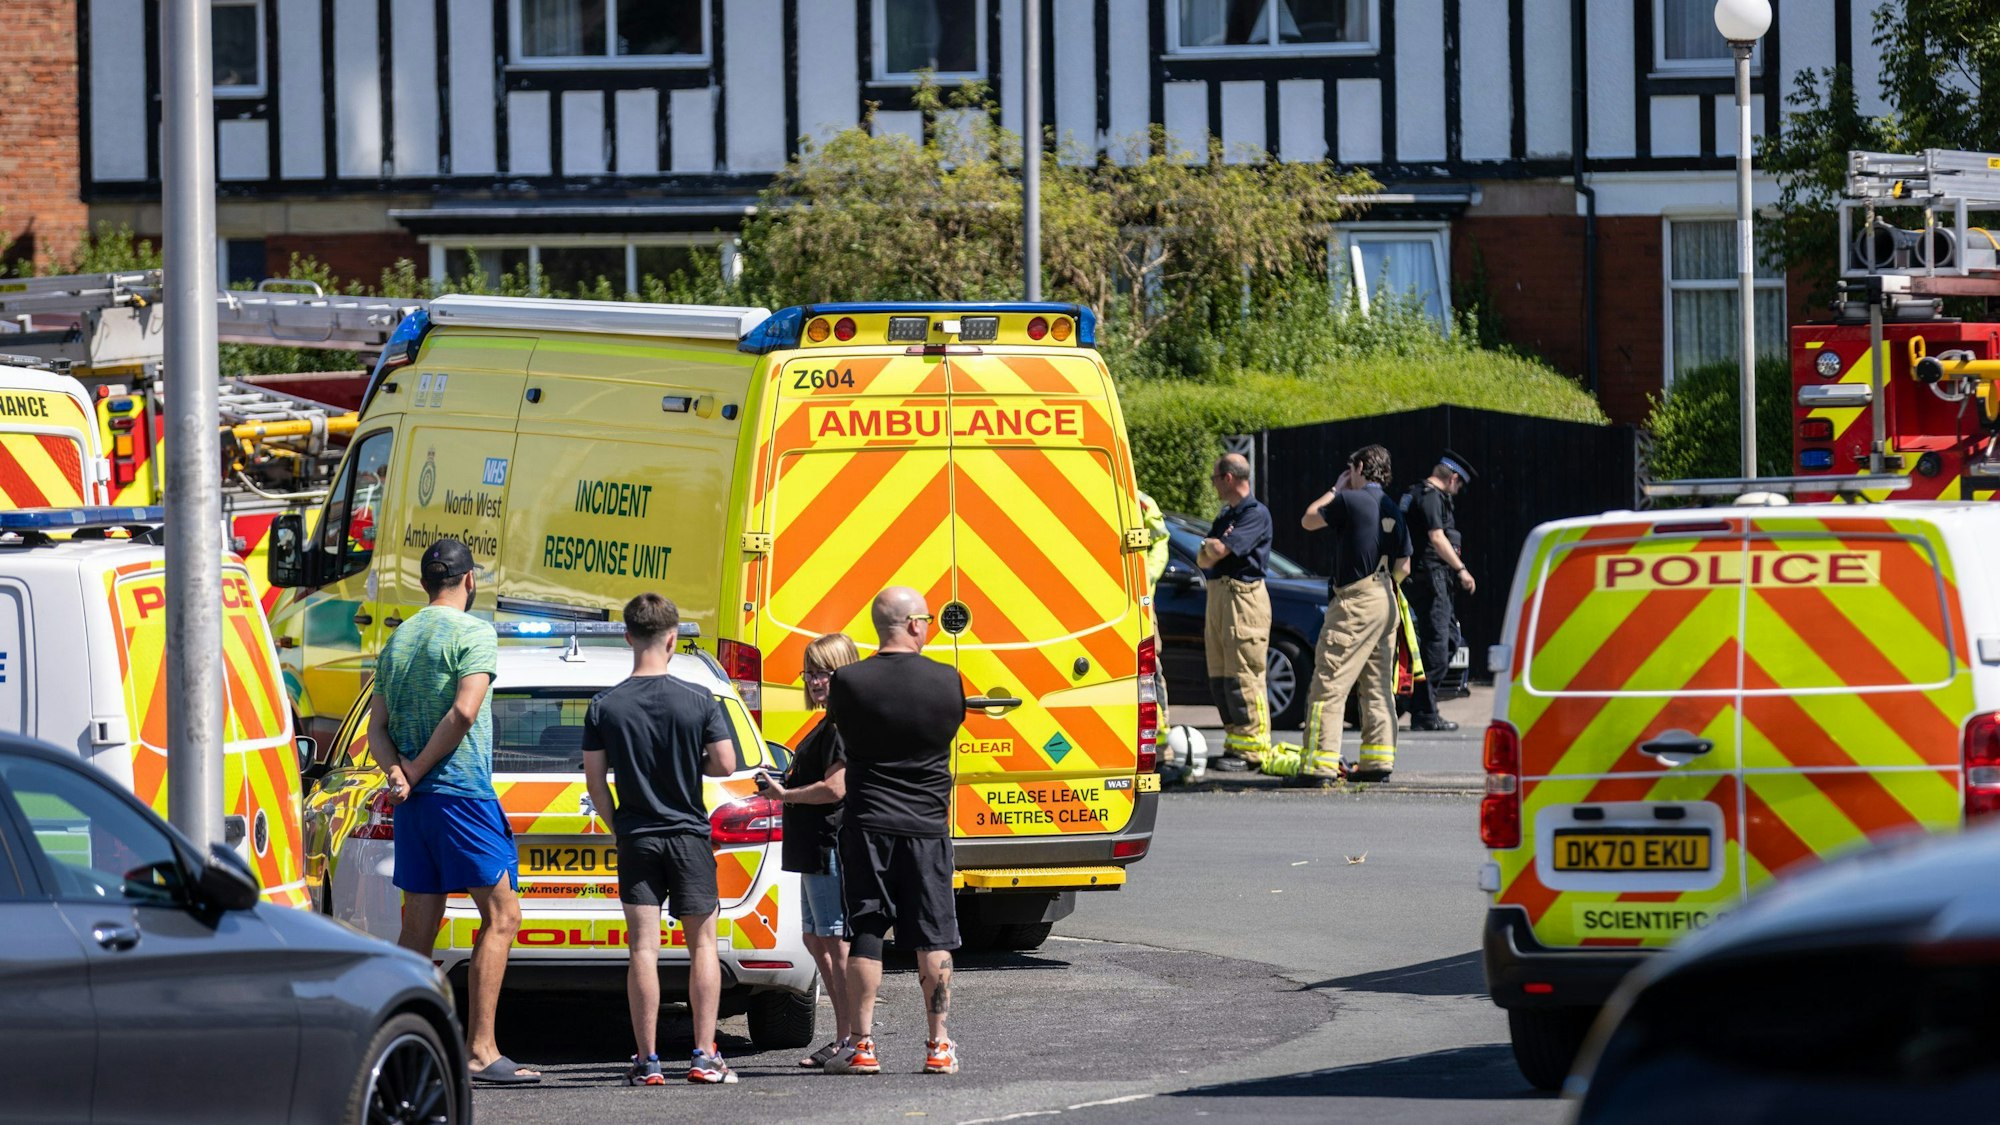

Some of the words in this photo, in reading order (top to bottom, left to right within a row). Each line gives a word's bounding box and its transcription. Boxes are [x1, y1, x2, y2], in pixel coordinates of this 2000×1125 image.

[793, 368, 855, 390] Z604
[818, 409, 1077, 437] AMBULANCE
[484, 460, 507, 484] NHS
[445, 489, 473, 516] North
[476, 492, 502, 518] West
[575, 480, 652, 518] INCIDENT
[543, 534, 629, 576] RESPONSE
[632, 543, 672, 580] UNIT
[1605, 554, 1868, 588] POLICE
[132, 578, 253, 619] PCE
[959, 742, 1011, 754] CLEAR
[987, 790, 1047, 804] PLEASE
[1052, 788, 1099, 803] LEAVE
[976, 813, 985, 826] 3
[990, 810, 1054, 825] METRES
[1058, 809, 1109, 823] CLEAR
[530, 849, 596, 871] DK20
[1567, 841, 1635, 866] DK70
[1645, 840, 1698, 866] EKU
[517, 884, 618, 896] ww.merseyside.
[1584, 910, 1709, 930] SCIENTIFIC
